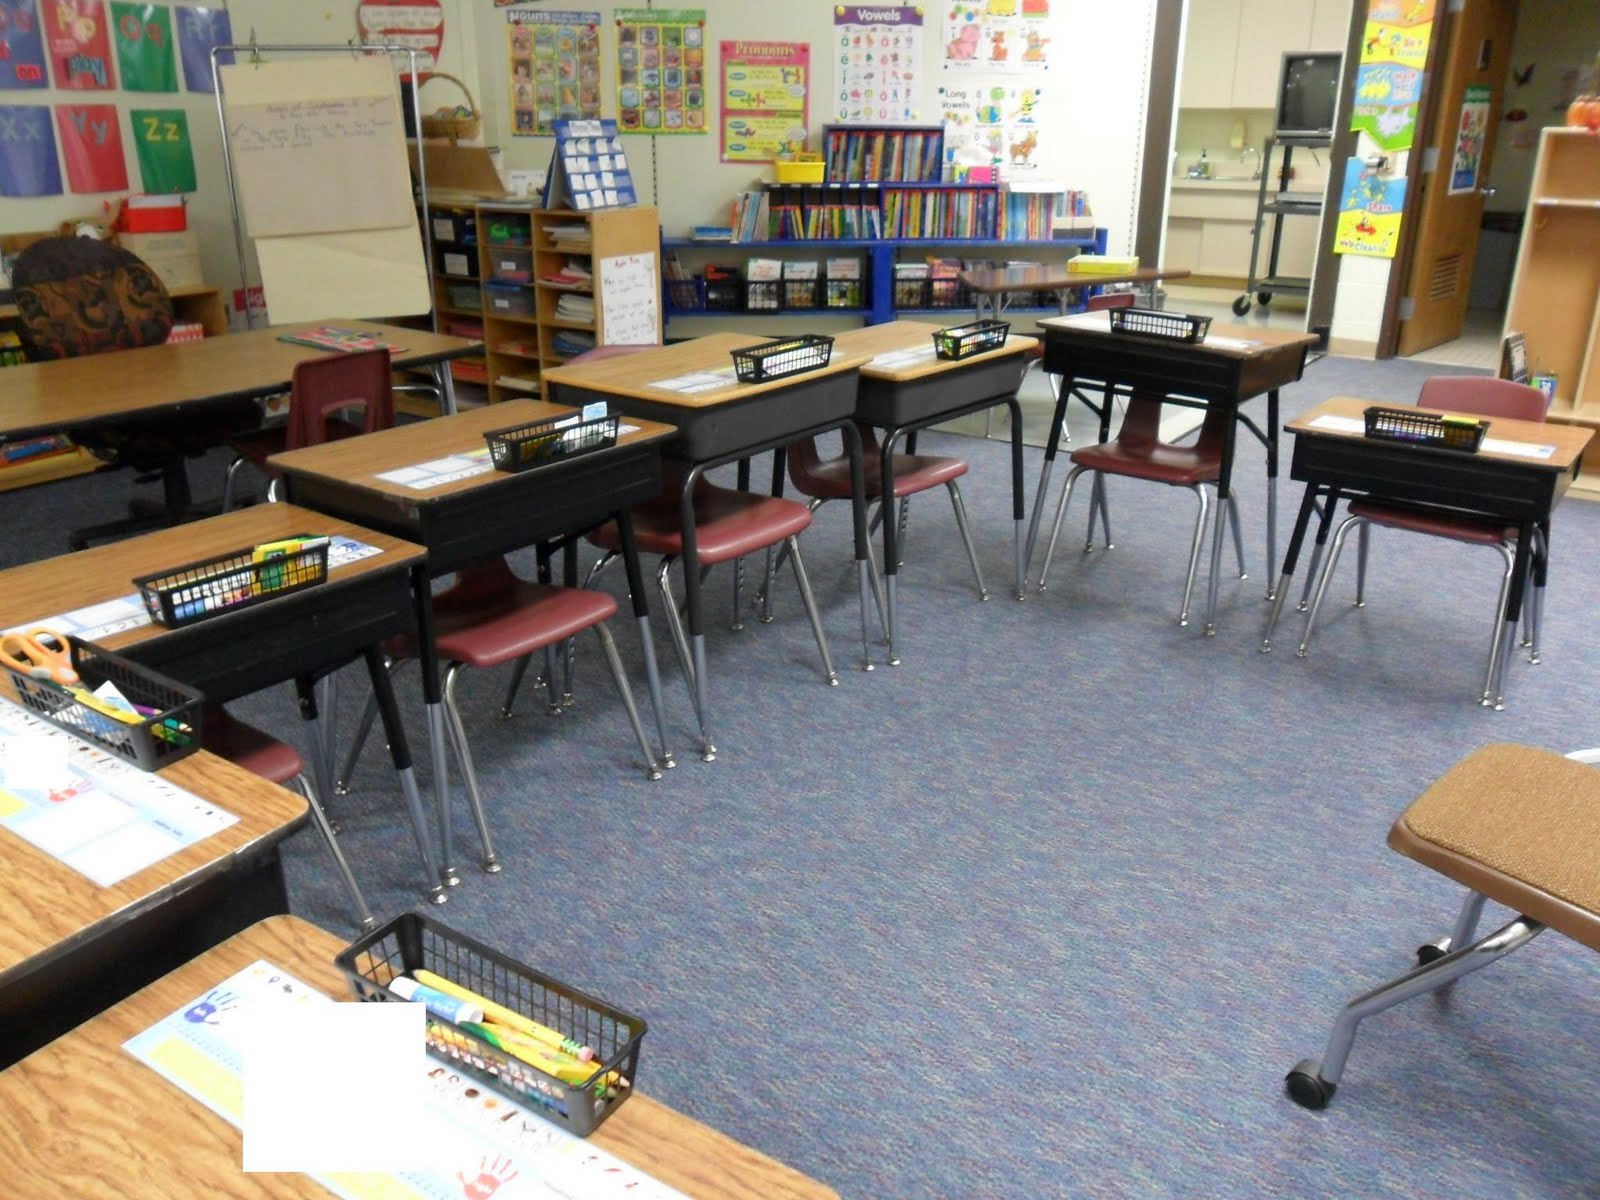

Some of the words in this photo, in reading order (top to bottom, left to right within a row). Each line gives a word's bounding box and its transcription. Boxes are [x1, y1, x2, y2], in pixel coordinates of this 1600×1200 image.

[857, 9, 901, 21] Vowels
[120, 16, 163, 48] Qq
[734, 42, 796, 57] Pronouns
[945, 90, 967, 100] Long
[941, 101, 970, 110] Vowels
[1, 115, 41, 143] Xx
[71, 112, 109, 145] Yy
[143, 117, 180, 142] Zz
